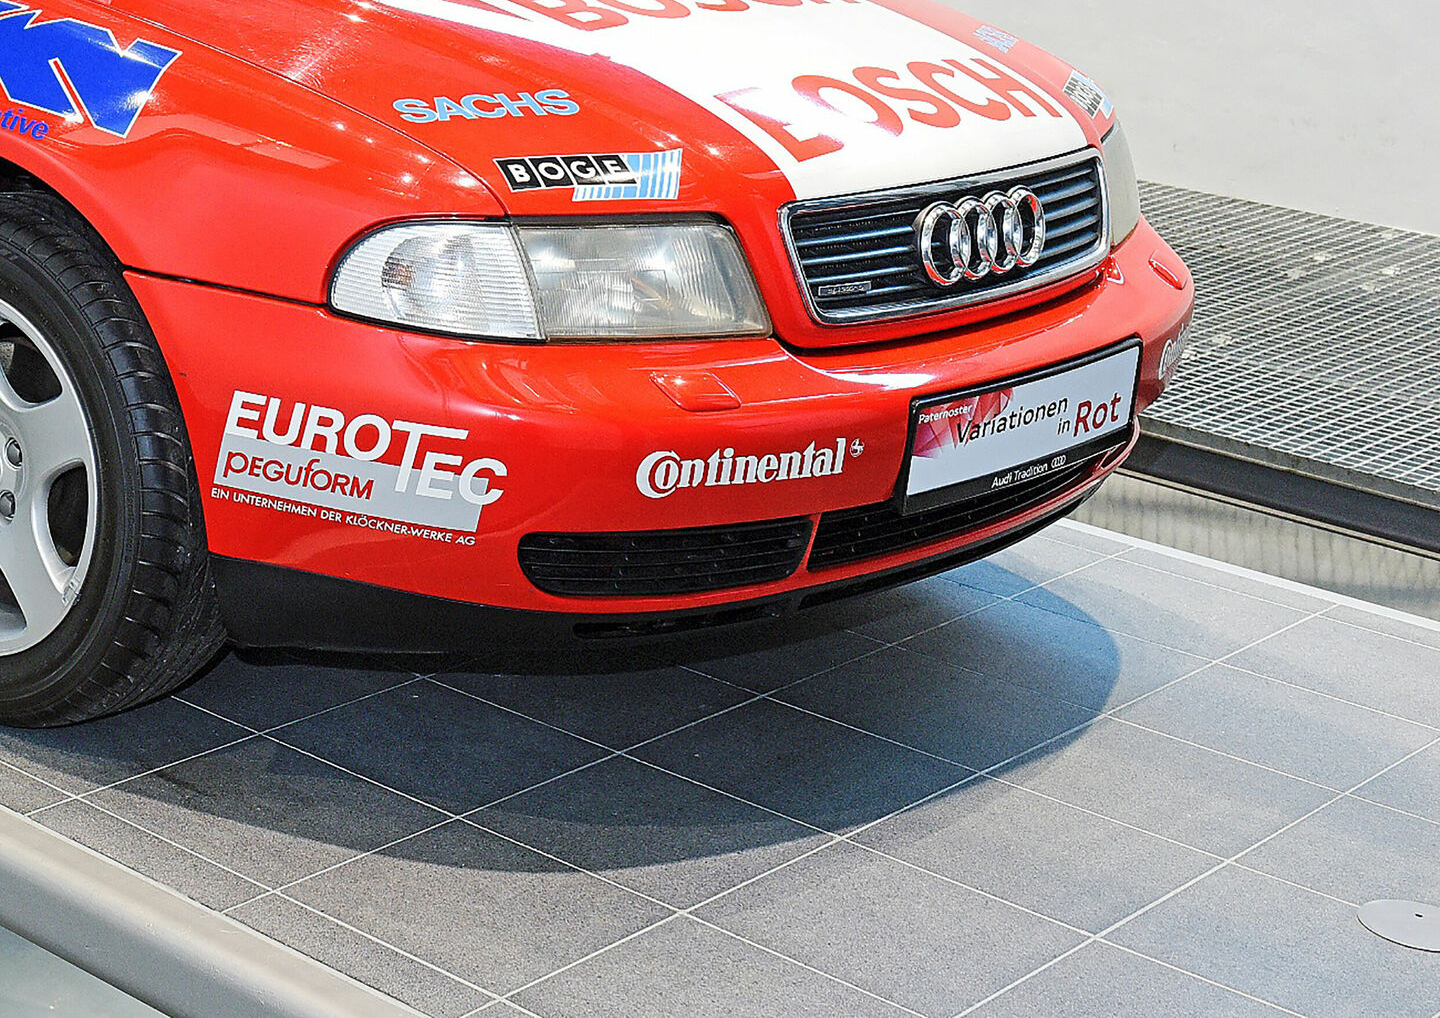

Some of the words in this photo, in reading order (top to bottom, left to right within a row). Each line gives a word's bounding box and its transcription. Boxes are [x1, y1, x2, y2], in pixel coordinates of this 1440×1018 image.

[393, 89, 580, 122] SACHS
[510, 159, 632, 185] BOGE
[918, 404, 973, 424] Paternoster
[957, 397, 1068, 443] Variationen
[1058, 418, 1071, 435] in
[1073, 393, 1121, 437] Rot
[226, 390, 508, 505] EUROTEC
[636, 438, 846, 499] Continental
[992, 472, 1012, 488] Audi
[1014, 463, 1048, 481] Tradition
[211, 488, 229, 499] EIN
[233, 493, 317, 517] UNTERNEHMEN
[320, 509, 342, 522] DER
[345, 513, 452, 543] KLÖCKNER-WERKE
[456, 533, 476, 546] AG
